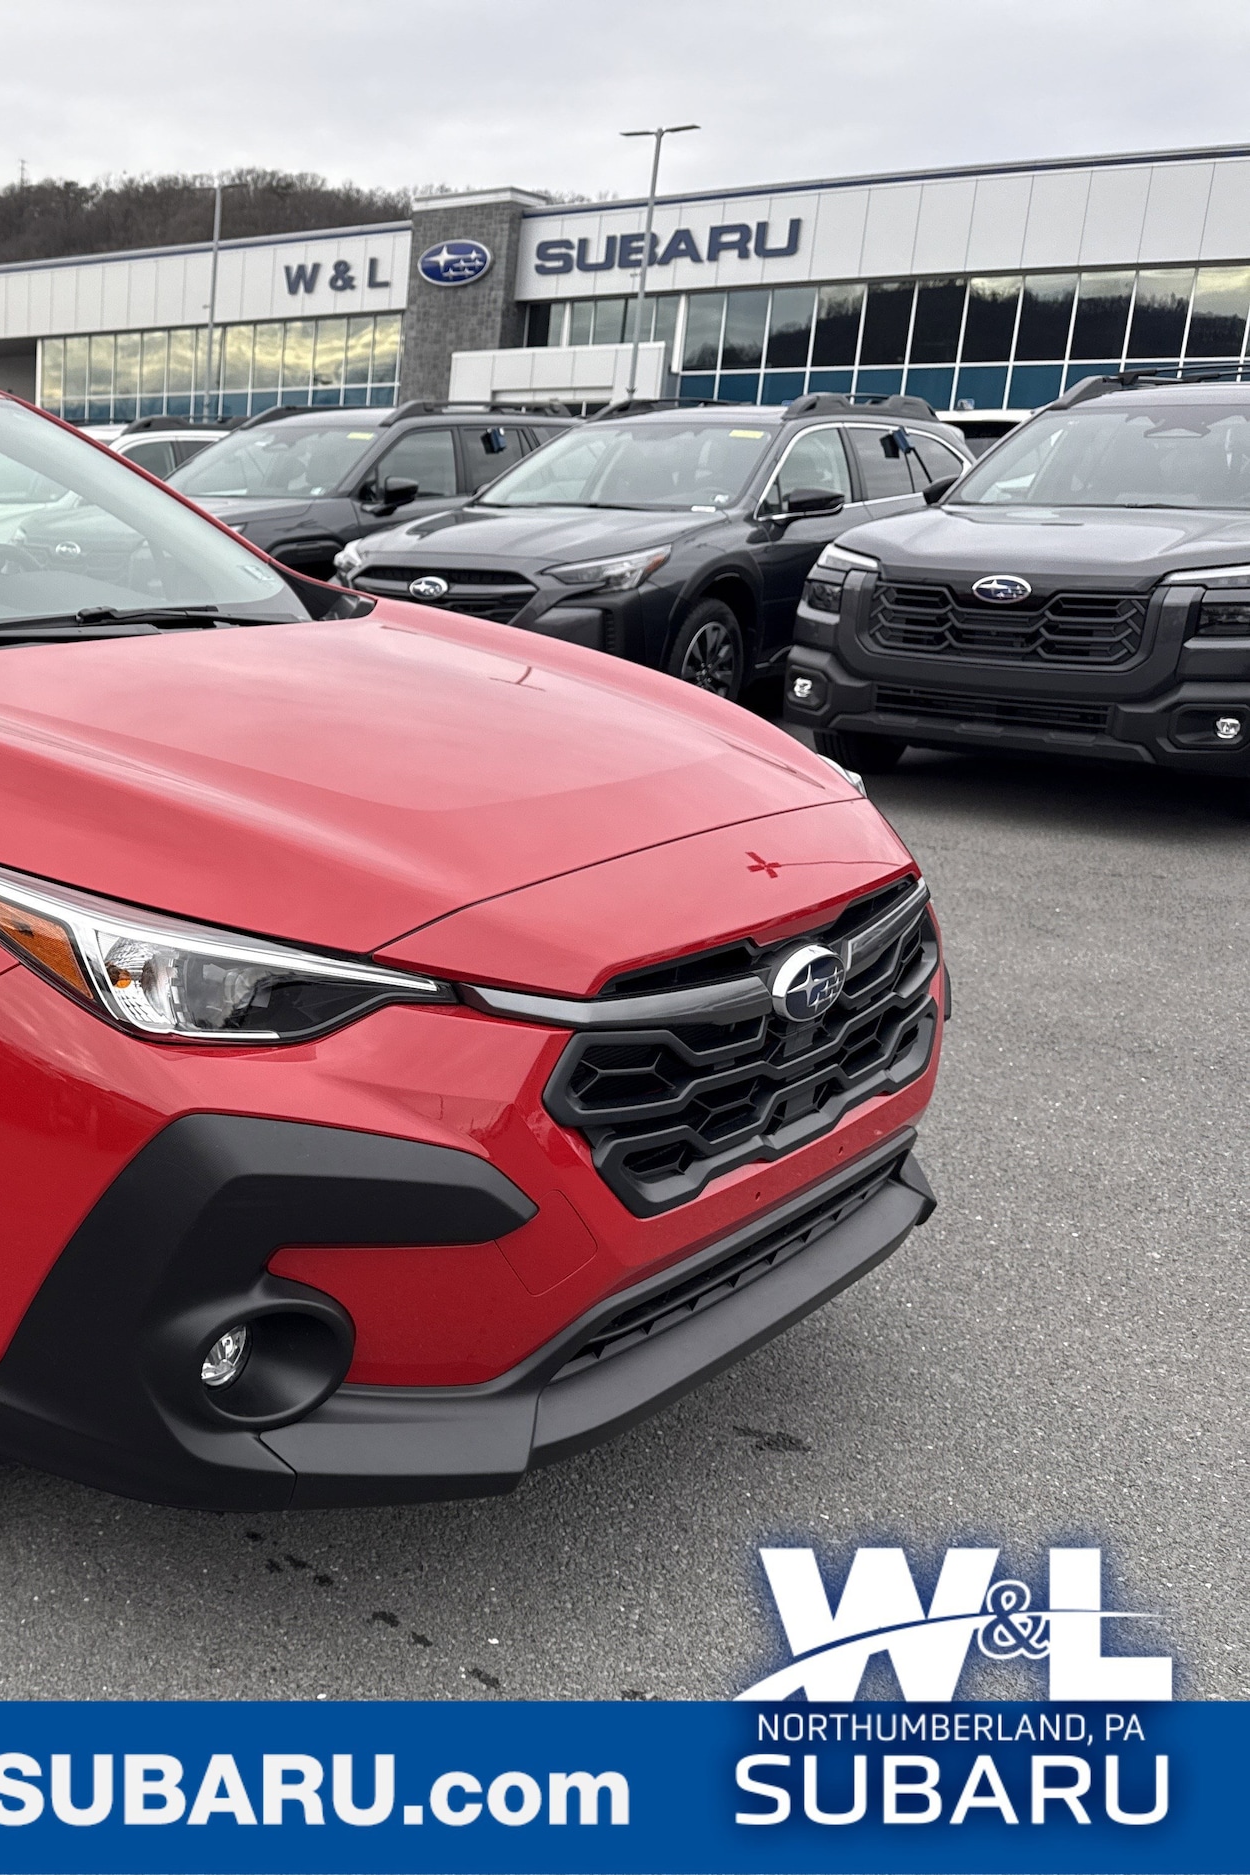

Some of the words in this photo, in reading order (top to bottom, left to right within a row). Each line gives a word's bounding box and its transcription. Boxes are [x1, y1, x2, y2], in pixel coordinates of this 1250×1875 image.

[534, 218, 801, 275] SUBARU
[284, 262, 321, 295] W
[329, 260, 355, 291] &
[368, 257, 391, 288] L
